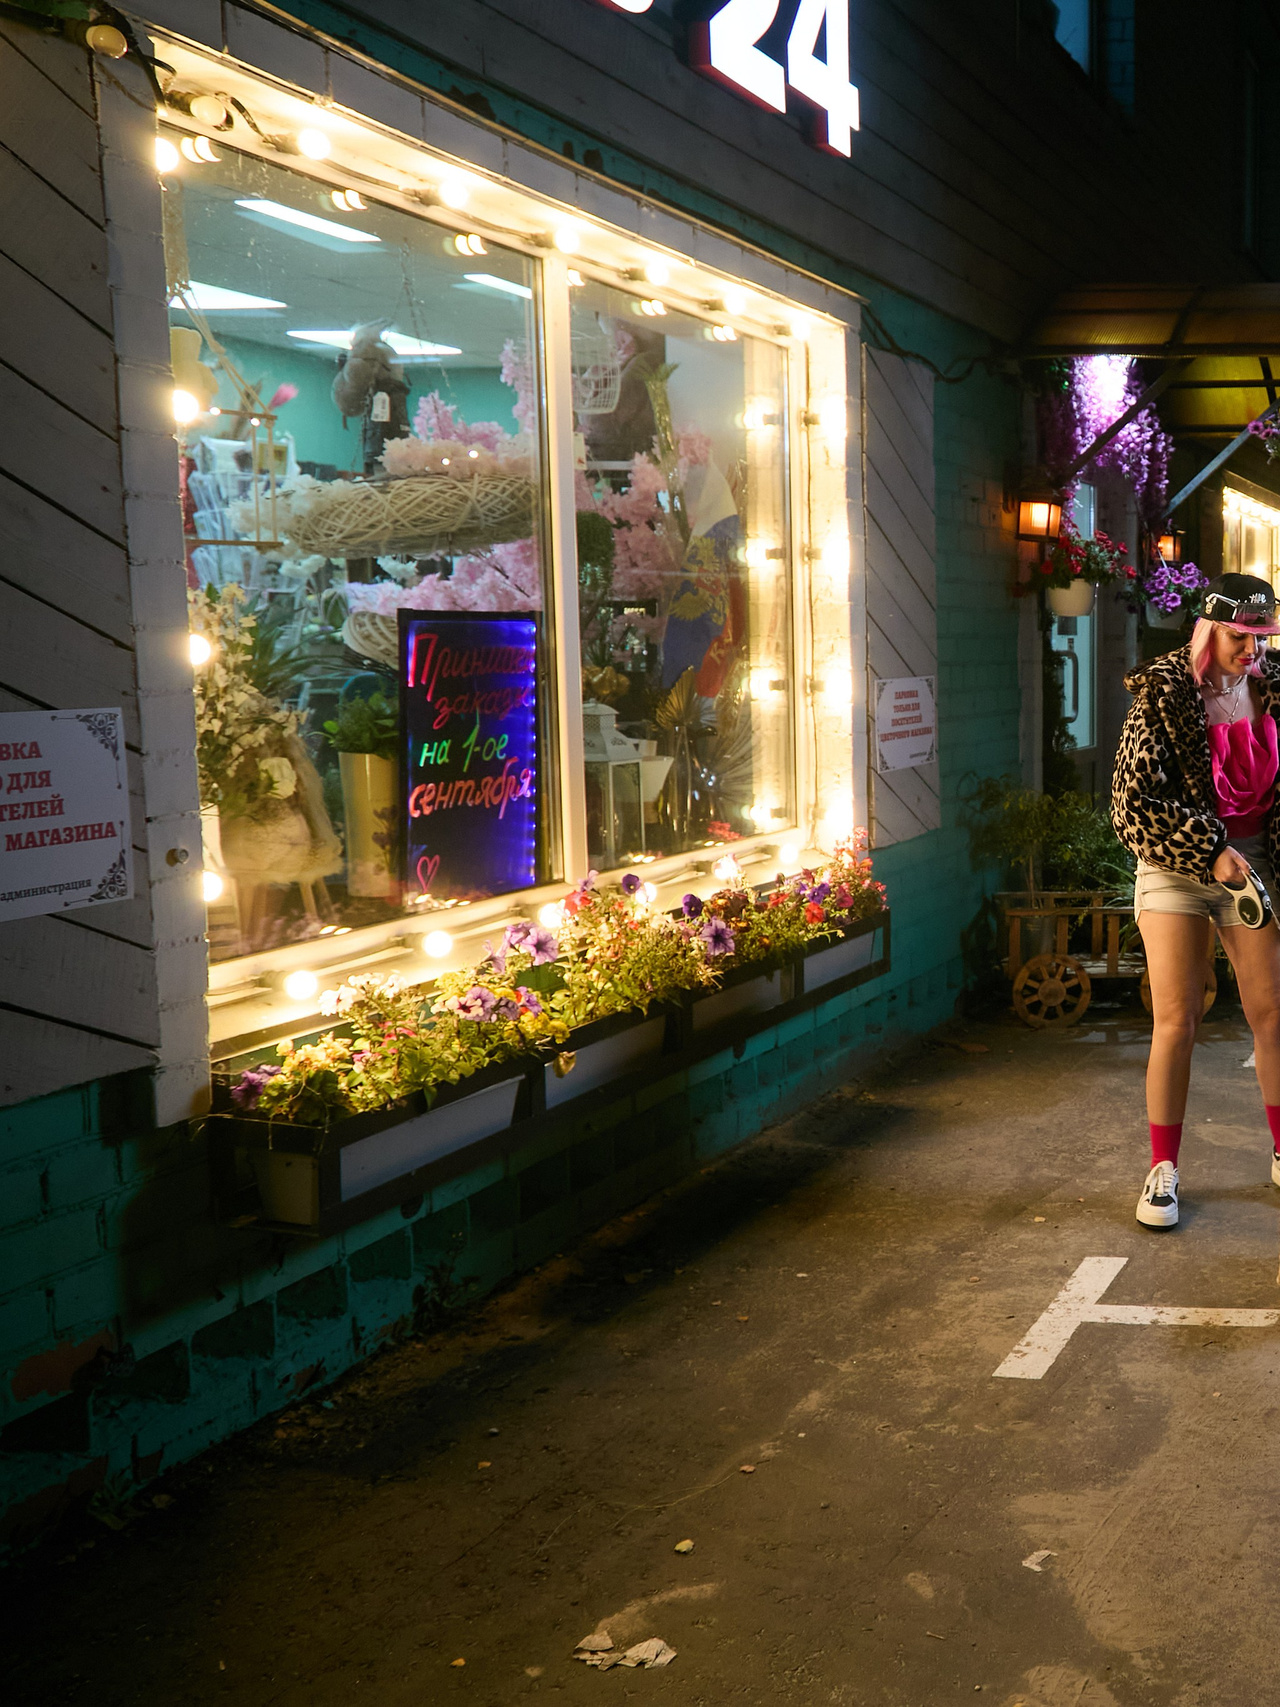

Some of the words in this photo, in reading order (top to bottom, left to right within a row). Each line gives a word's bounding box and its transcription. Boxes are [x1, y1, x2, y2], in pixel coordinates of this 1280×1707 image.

[708, 0, 860, 158] 24
[419, 739, 451, 767] на
[6, 770, 52, 794] ДЛЯ
[5, 821, 118, 851] МАГАЗИНА
[0, 879, 92, 902] администрация
